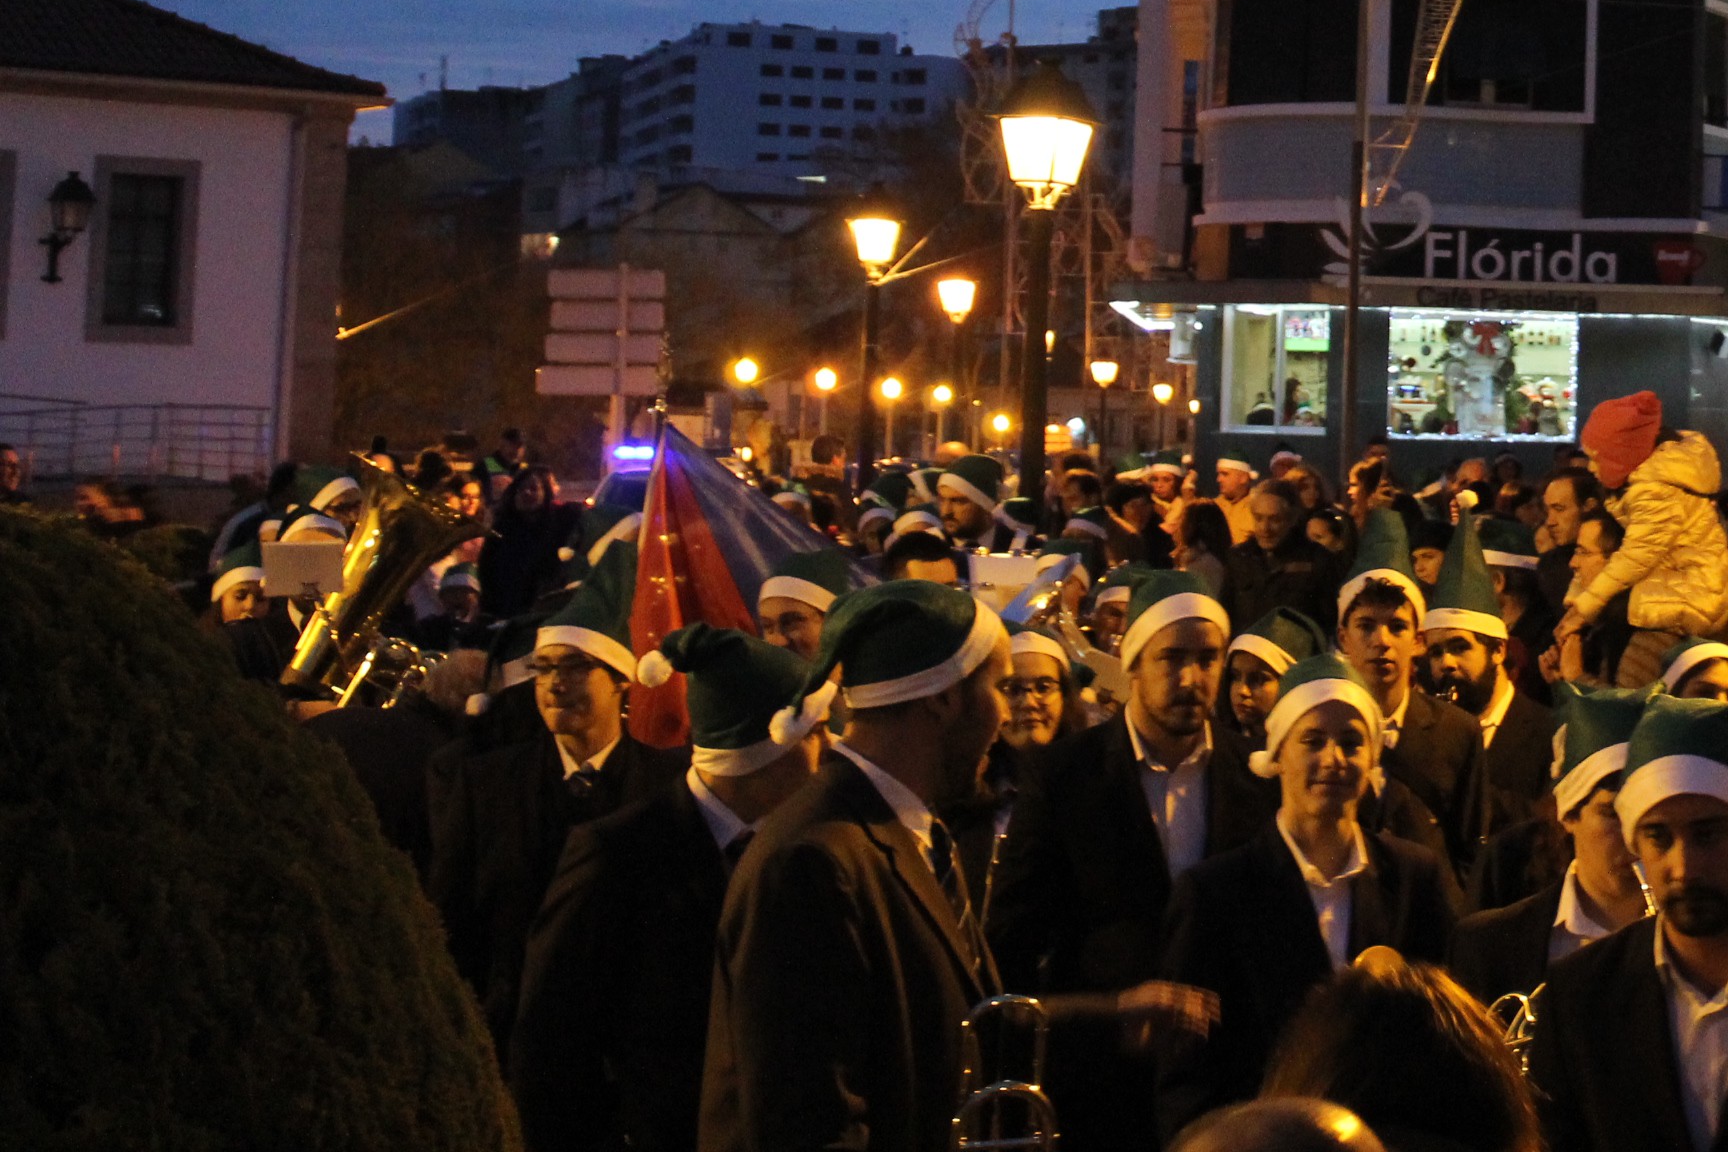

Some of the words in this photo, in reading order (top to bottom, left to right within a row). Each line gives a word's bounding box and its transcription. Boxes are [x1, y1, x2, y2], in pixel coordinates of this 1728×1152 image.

[1424, 230, 1618, 284] Flórida
[1417, 285, 1473, 307] Café
[1481, 287, 1597, 313] Pastelaria
